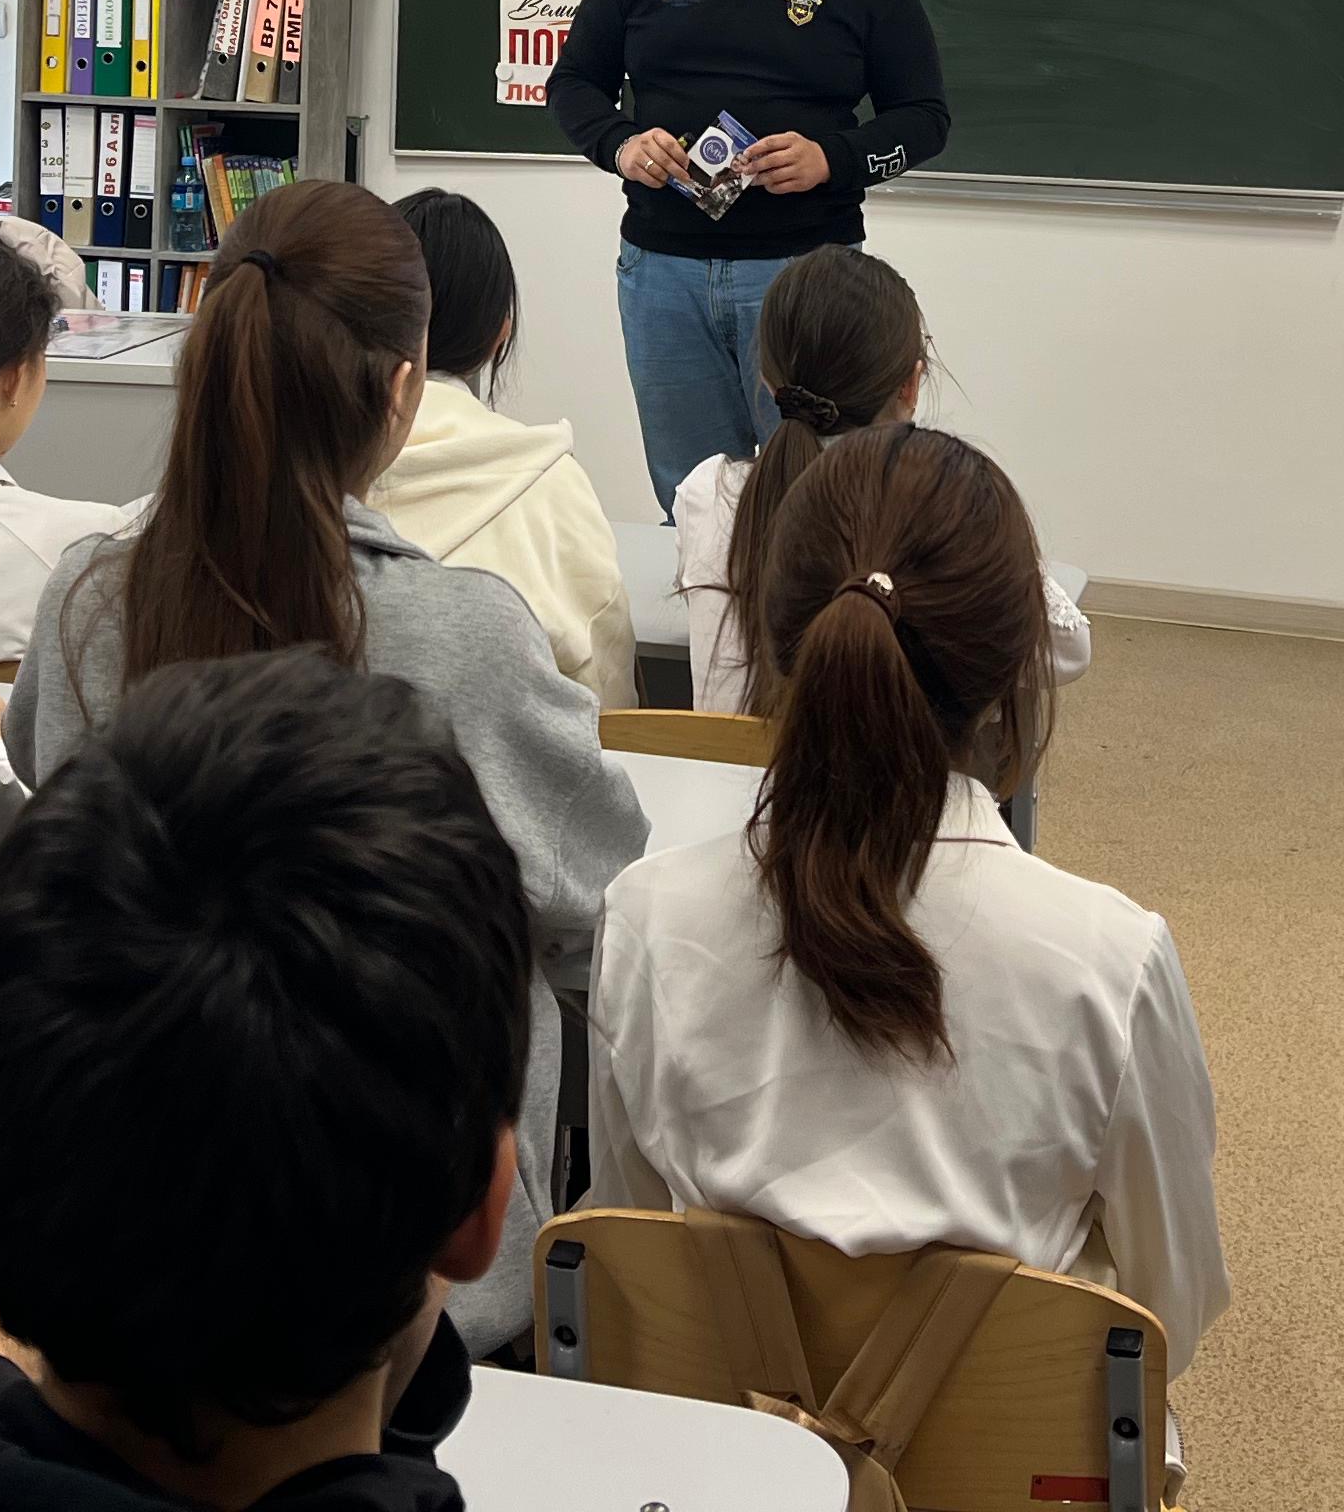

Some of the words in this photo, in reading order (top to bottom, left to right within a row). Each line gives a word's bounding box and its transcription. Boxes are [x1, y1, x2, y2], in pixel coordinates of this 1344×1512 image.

[260, 18, 275, 49] ВР
[505, 84, 547, 102] ЛЮ
[106, 140, 118, 153] А
[106, 157, 117, 167] 6
[104, 172, 116, 195] ВР
